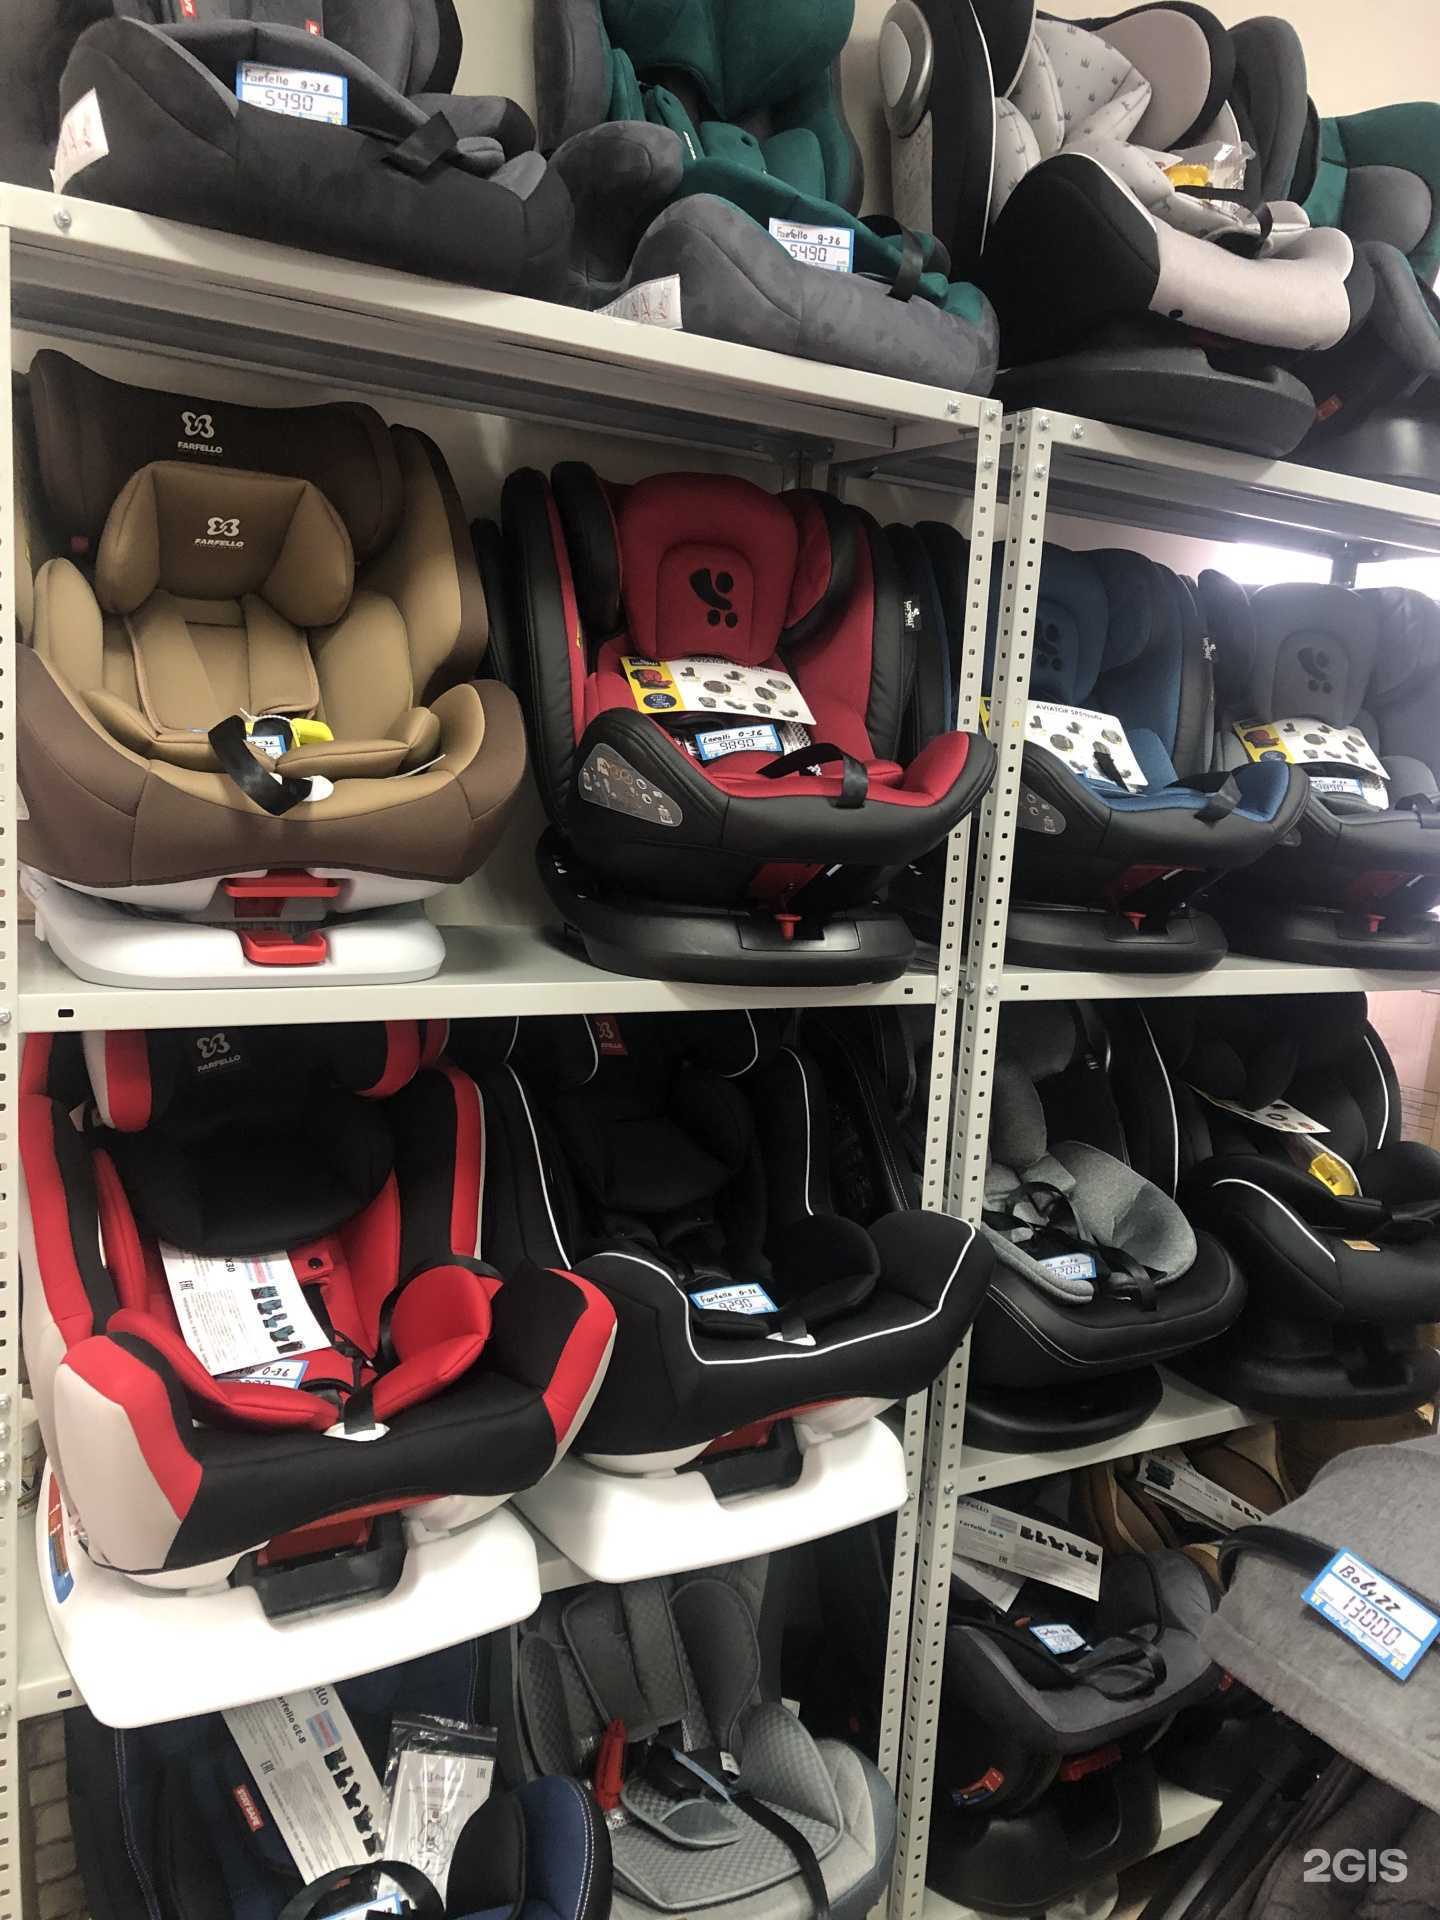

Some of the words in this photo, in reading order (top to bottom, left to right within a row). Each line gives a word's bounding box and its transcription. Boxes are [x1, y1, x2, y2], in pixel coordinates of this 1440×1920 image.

[264, 89, 314, 112] 5490
[789, 243, 828, 262] 5490
[177, 441, 223, 454] FARFELLO
[194, 538, 244, 548] FARFELLO
[1035, 703, 1069, 713] AVIATOR
[1342, 1594, 1403, 1646] 13000
